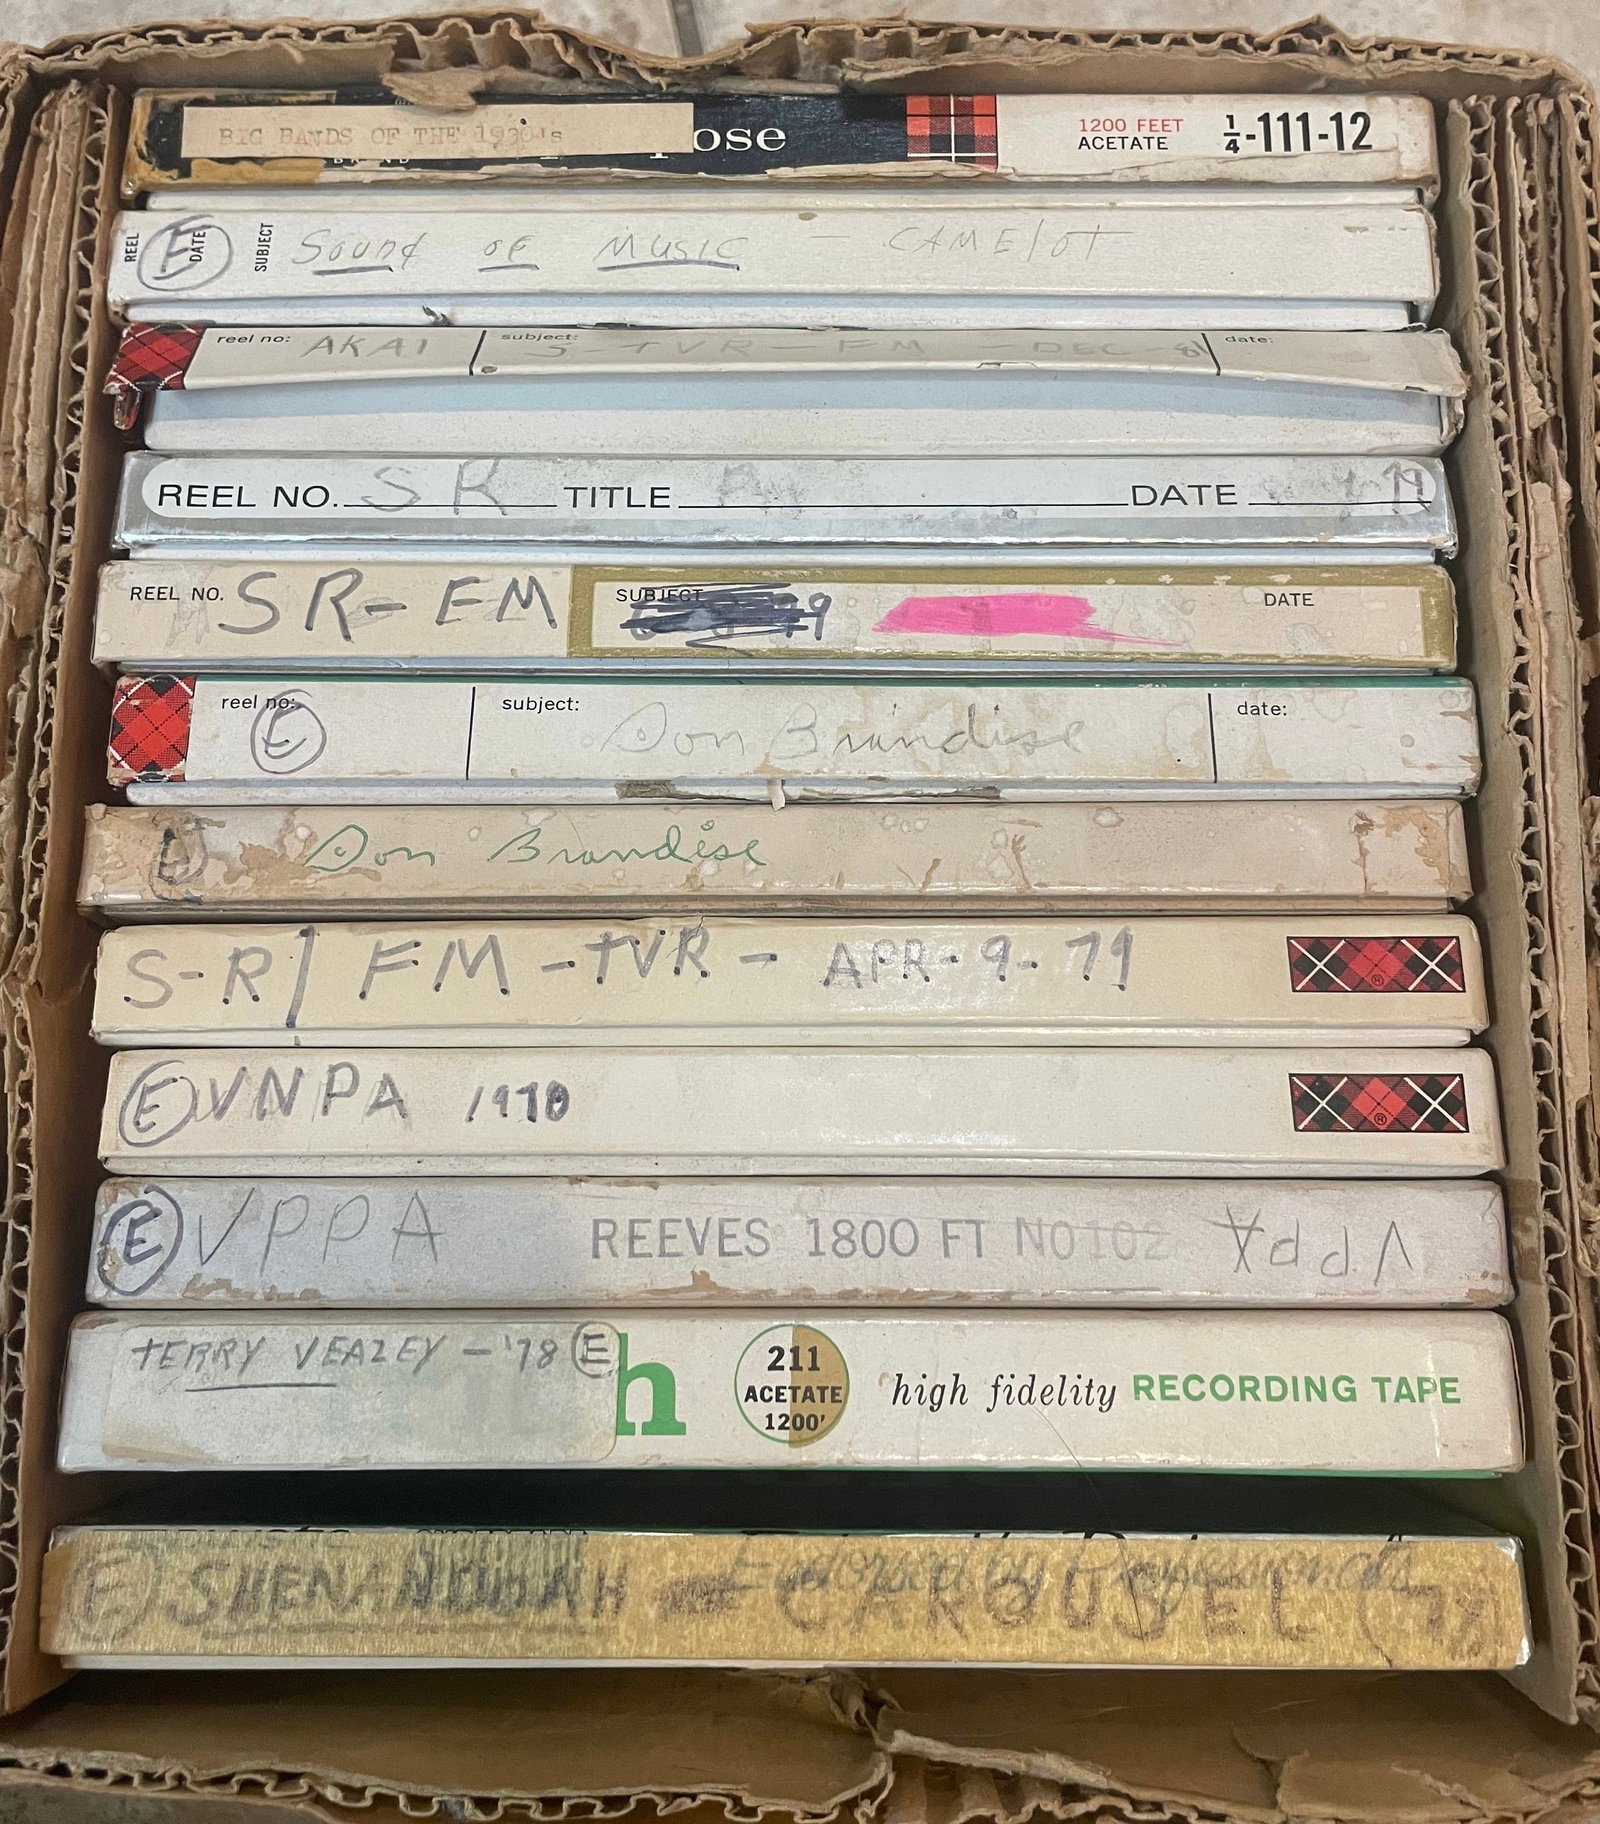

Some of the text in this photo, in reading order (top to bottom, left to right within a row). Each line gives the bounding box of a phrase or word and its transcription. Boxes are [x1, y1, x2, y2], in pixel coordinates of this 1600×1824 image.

[1078, 118, 1184, 133] 1200 FEET
[219, 127, 262, 146] BIG
[279, 127, 353, 147] BANDS
[371, 127, 400, 146] OF
[413, 126, 461, 146] THE
[1078, 136, 1168, 151] ACETATE
[124, 233, 139, 262] REEL
[189, 231, 206, 262] DATE
[254, 222, 274, 272] SUBJECT
[217, 332, 291, 344] reel no:
[501, 333, 578, 344] subject:
[1225, 335, 1274, 345] date:
[157, 484, 340, 508] REEL NO.
[563, 486, 671, 509] TITLE
[1131, 484, 1237, 507] DATE
[130, 586, 225, 602] REEL NO.
[1264, 592, 1314, 608] DATE
[221, 694, 300, 711] reel no:
[502, 695, 579, 713] subject:
[1237, 700, 1288, 717] date:
[592, 1217, 771, 1260] REEVES
[807, 1217, 919, 1260] 1800
[941, 1217, 987, 1260] FT
[767, 1345, 821, 1373] 211
[743, 1384, 843, 1406] ACETATE
[891, 1373, 1118, 1412] high fidelity
[1132, 1373, 1461, 1405] RECORDING TAPE
[764, 1413, 826, 1433] 1200'
